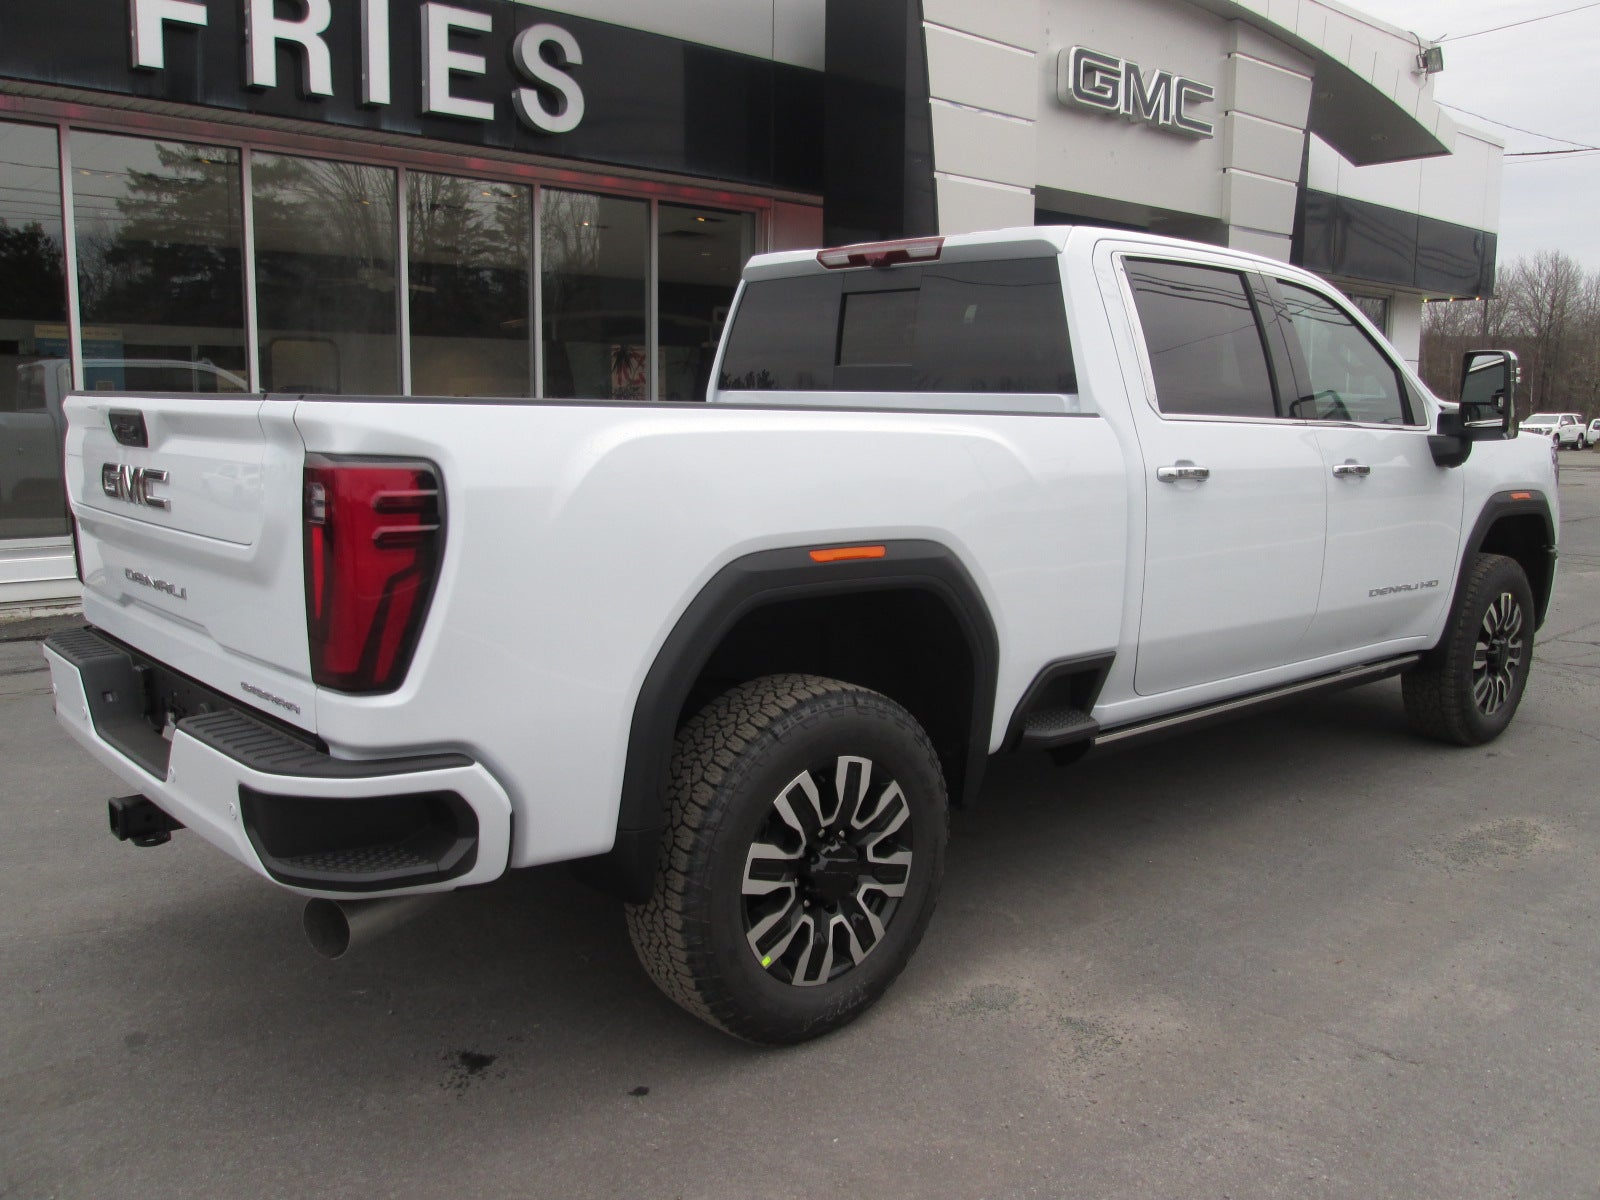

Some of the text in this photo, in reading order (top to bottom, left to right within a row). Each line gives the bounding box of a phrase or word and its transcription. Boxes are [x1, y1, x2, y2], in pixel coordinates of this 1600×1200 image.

[131, 0, 586, 134] FRIES
[1058, 45, 1215, 139] GMC
[101, 462, 170, 509] GMC
[125, 568, 187, 600] DENALI
[1368, 579, 1439, 597] DENALI HD
